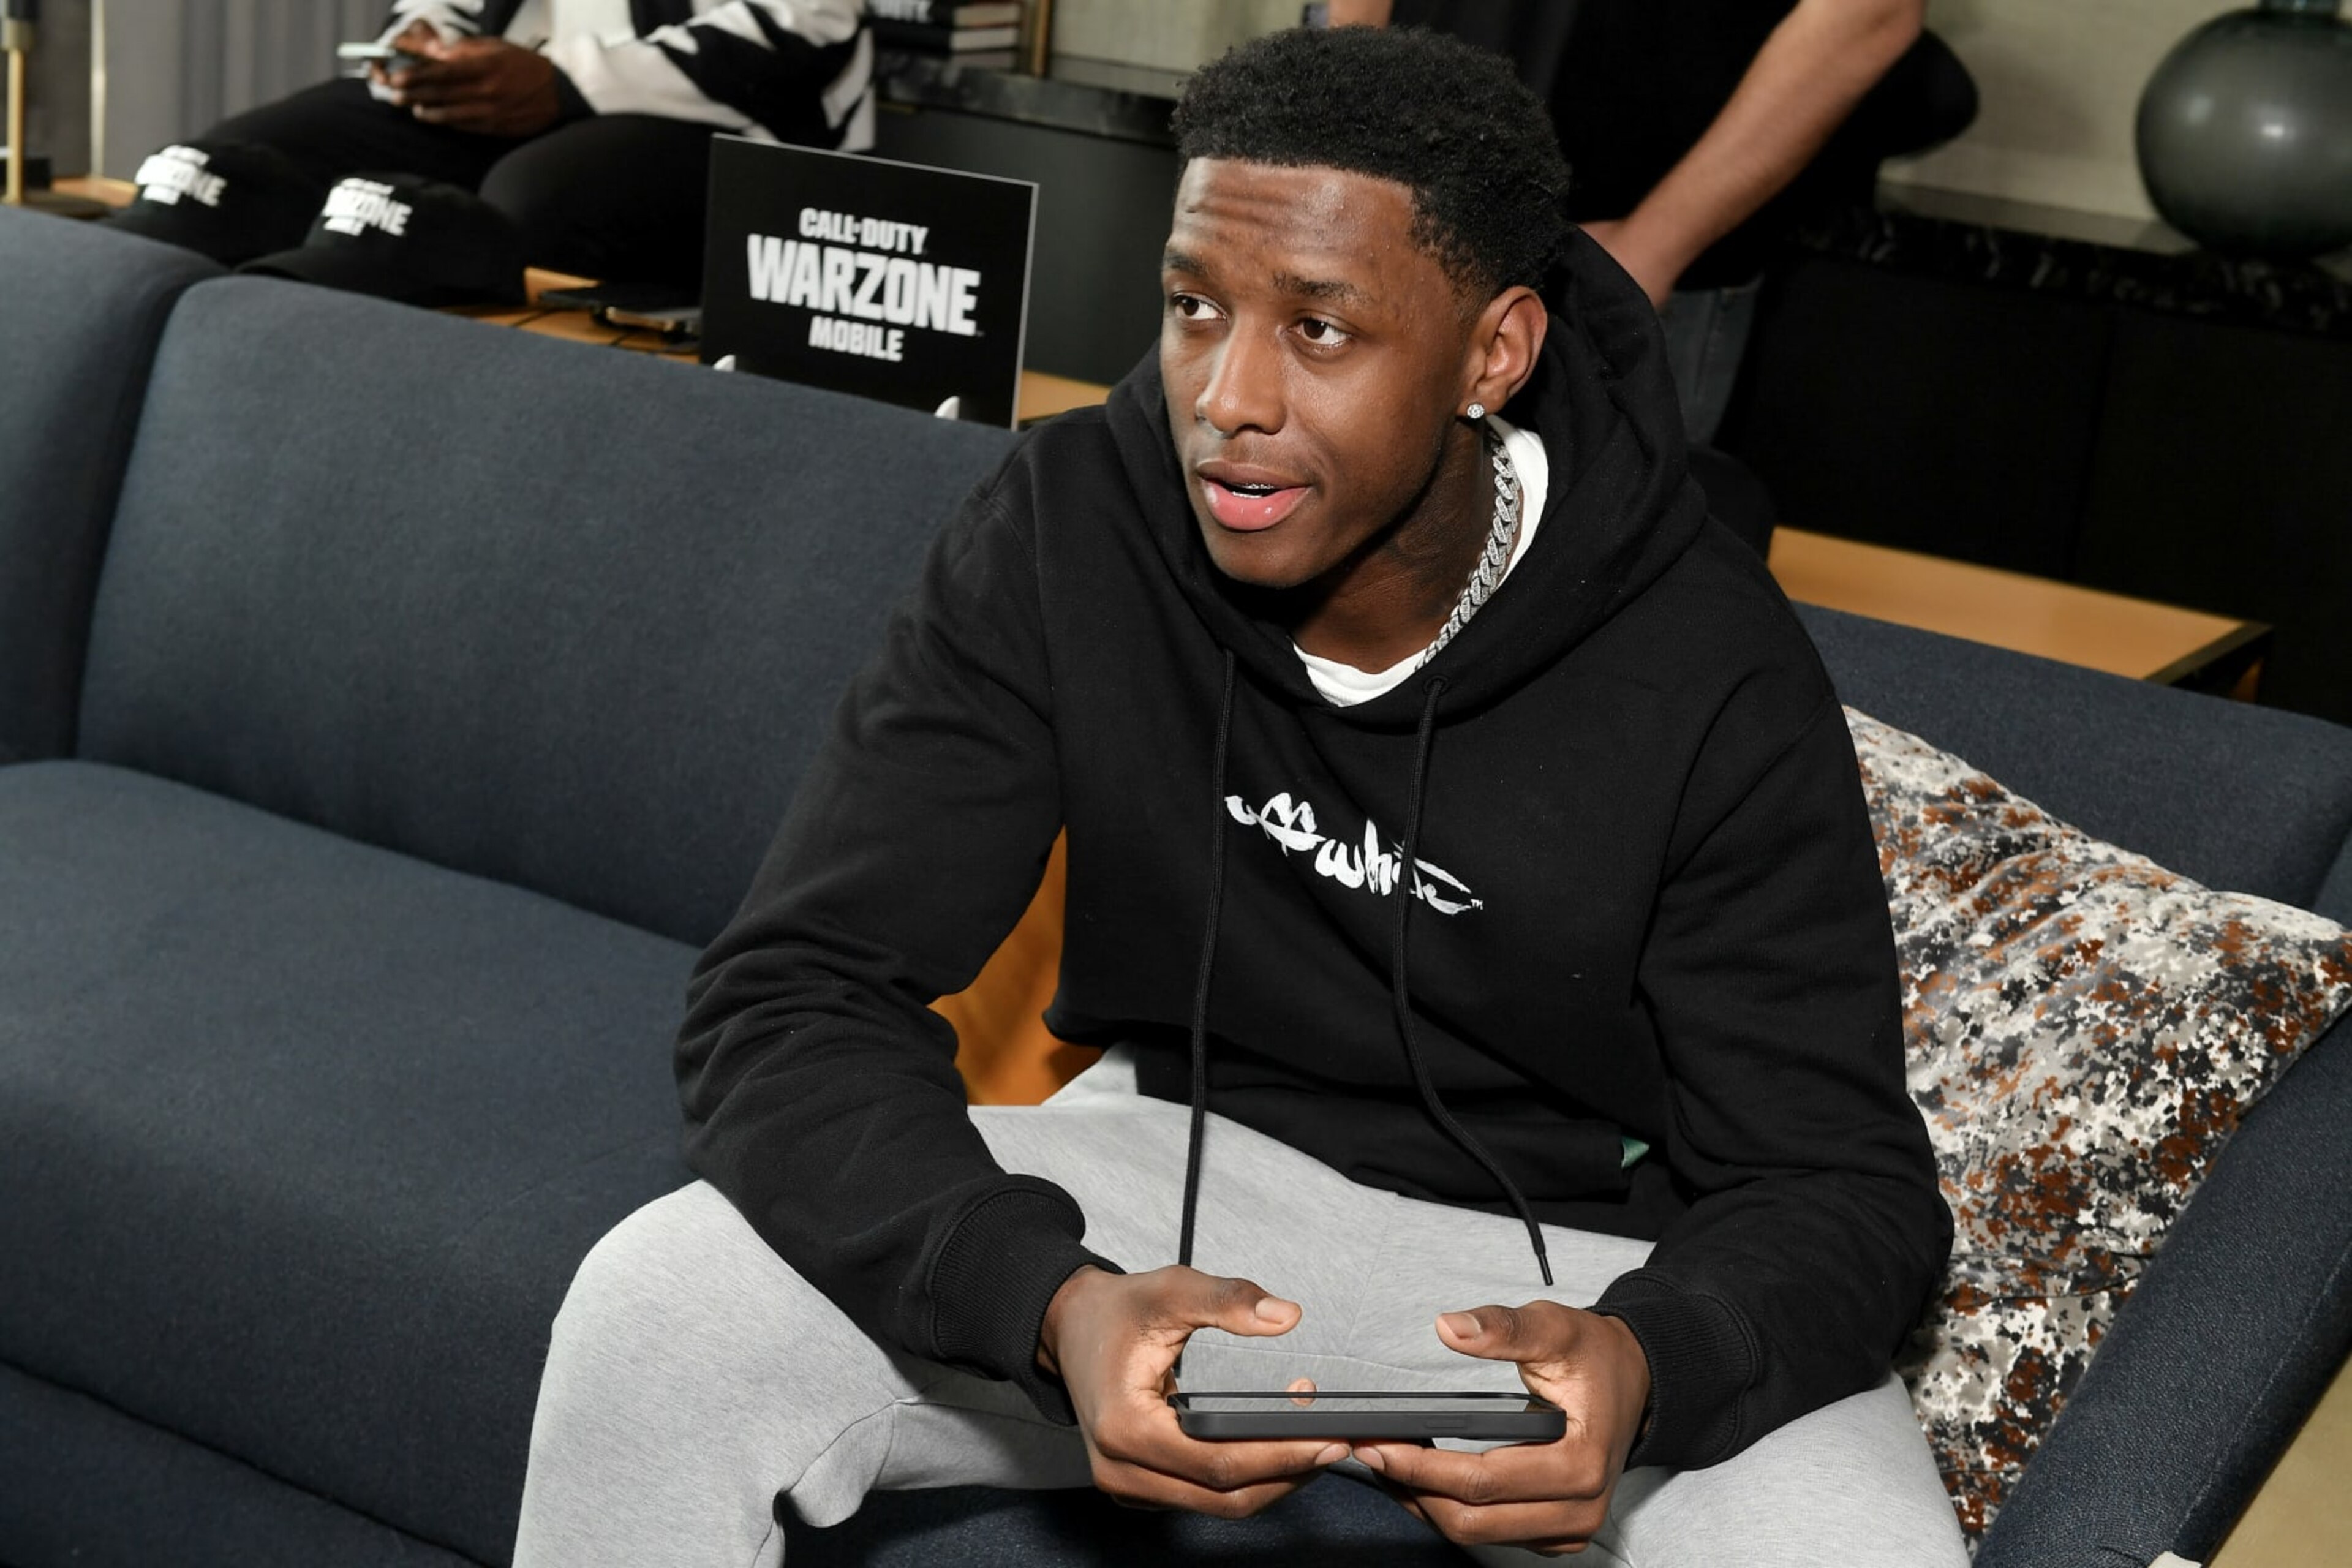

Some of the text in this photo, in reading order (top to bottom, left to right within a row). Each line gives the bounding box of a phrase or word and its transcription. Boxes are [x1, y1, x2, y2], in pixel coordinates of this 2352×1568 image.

[799, 207, 929, 255] CALL DUTY
[747, 233, 981, 336] WARZONE
[809, 315, 905, 362] MOBILE
